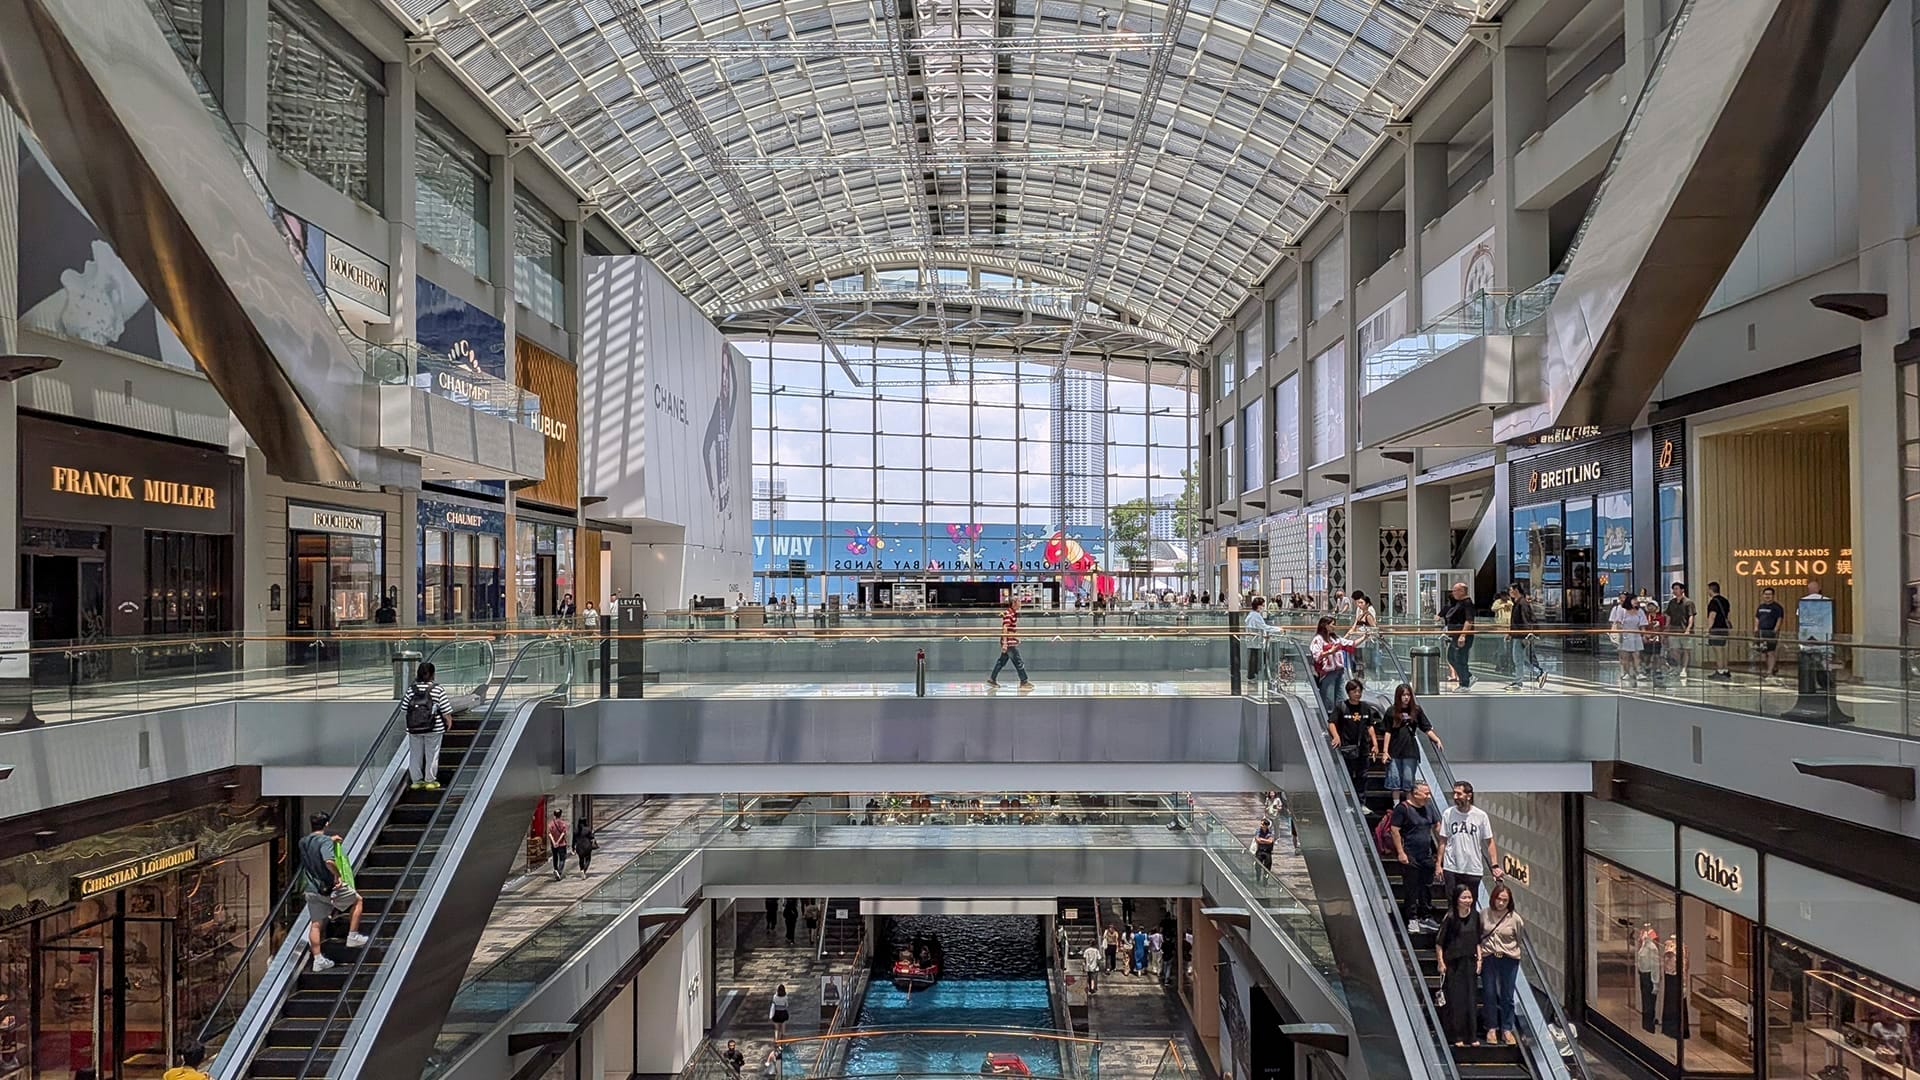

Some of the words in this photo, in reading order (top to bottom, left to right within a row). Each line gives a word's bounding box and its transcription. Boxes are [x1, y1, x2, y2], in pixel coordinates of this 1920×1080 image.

[328, 253, 387, 297] BOUCHERON
[654, 384, 689, 425] CHANEL
[530, 411, 567, 442] HUBLOT
[52, 465, 134, 499] FRANCK
[144, 479, 215, 509] MULLER
[1541, 461, 1600, 489] BREITLING
[313, 512, 362, 530] BOUCHERON
[773, 536, 813, 556] WAY
[1734, 549, 1772, 557] MARINA
[1736, 560, 1828, 575] CASINO
[1756, 578, 1808, 586] SINGAPORE
[627, 608, 633, 621] 1
[1451, 822, 1477, 835] GAP
[82, 867, 138, 894] CHRISTIAN
[141, 848, 195, 876] LOUBOUTIN
[1695, 852, 1738, 891] Chloé
